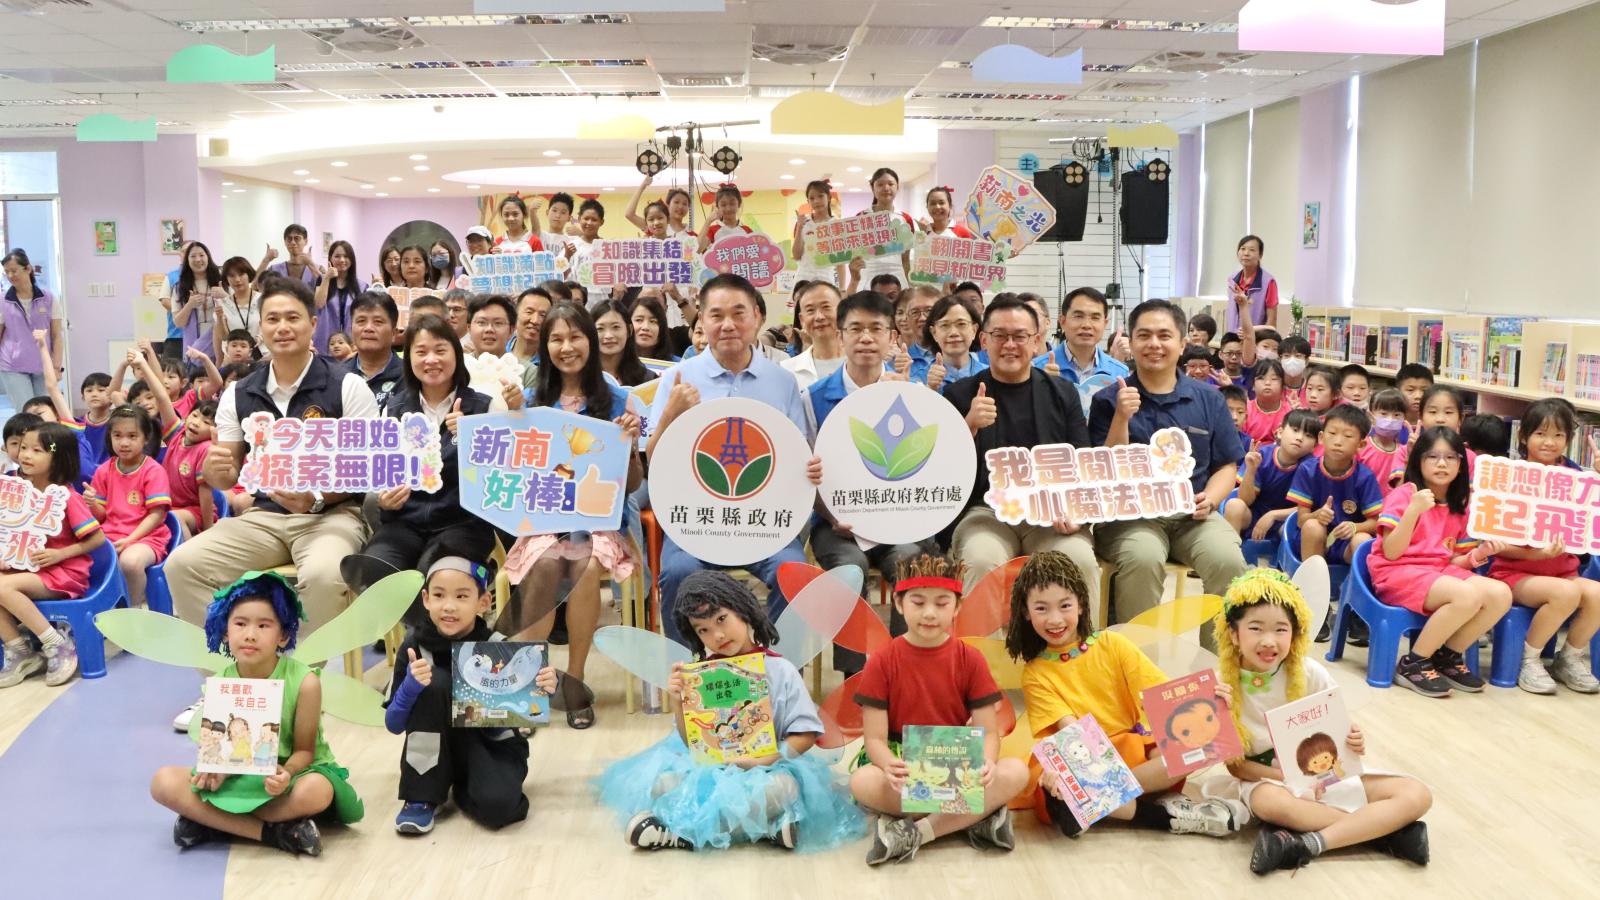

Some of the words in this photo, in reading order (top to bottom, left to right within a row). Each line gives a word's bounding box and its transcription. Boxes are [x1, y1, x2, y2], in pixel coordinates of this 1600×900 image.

[979, 174, 1049, 233] 新南之光
[815, 213, 891, 239] 故事正精彩
[602, 240, 684, 260] 知識集結
[716, 244, 760, 262] 我們愛
[815, 230, 897, 255] 等你來發現!
[930, 236, 993, 262] 翻開書
[475, 253, 555, 275] 知識滿點
[592, 262, 693, 286] 冒險出發
[731, 260, 770, 281] 閱讀
[914, 258, 1007, 283] 遇見新世界
[272, 418, 400, 450] 今天開始
[470, 425, 552, 468] 新南
[259, 453, 420, 489] 探索無限!
[987, 446, 1154, 490] 我是閱讀
[483, 469, 564, 512] 好棒
[831, 485, 962, 506] 苗栗縣政府教育處
[1479, 460, 1600, 507] 讓想像力
[1027, 481, 1190, 521] 小魔法師!
[669, 505, 793, 528] 苗栗縣政府
[680, 527, 703, 536] Miaoli
[704, 528, 732, 538] County
[733, 530, 781, 539] Government
[0, 530, 40, 563] 來
[219, 683, 253, 695] 我喜歡
[234, 697, 267, 709] 我自己
[1286, 703, 1329, 729] 大家好!
